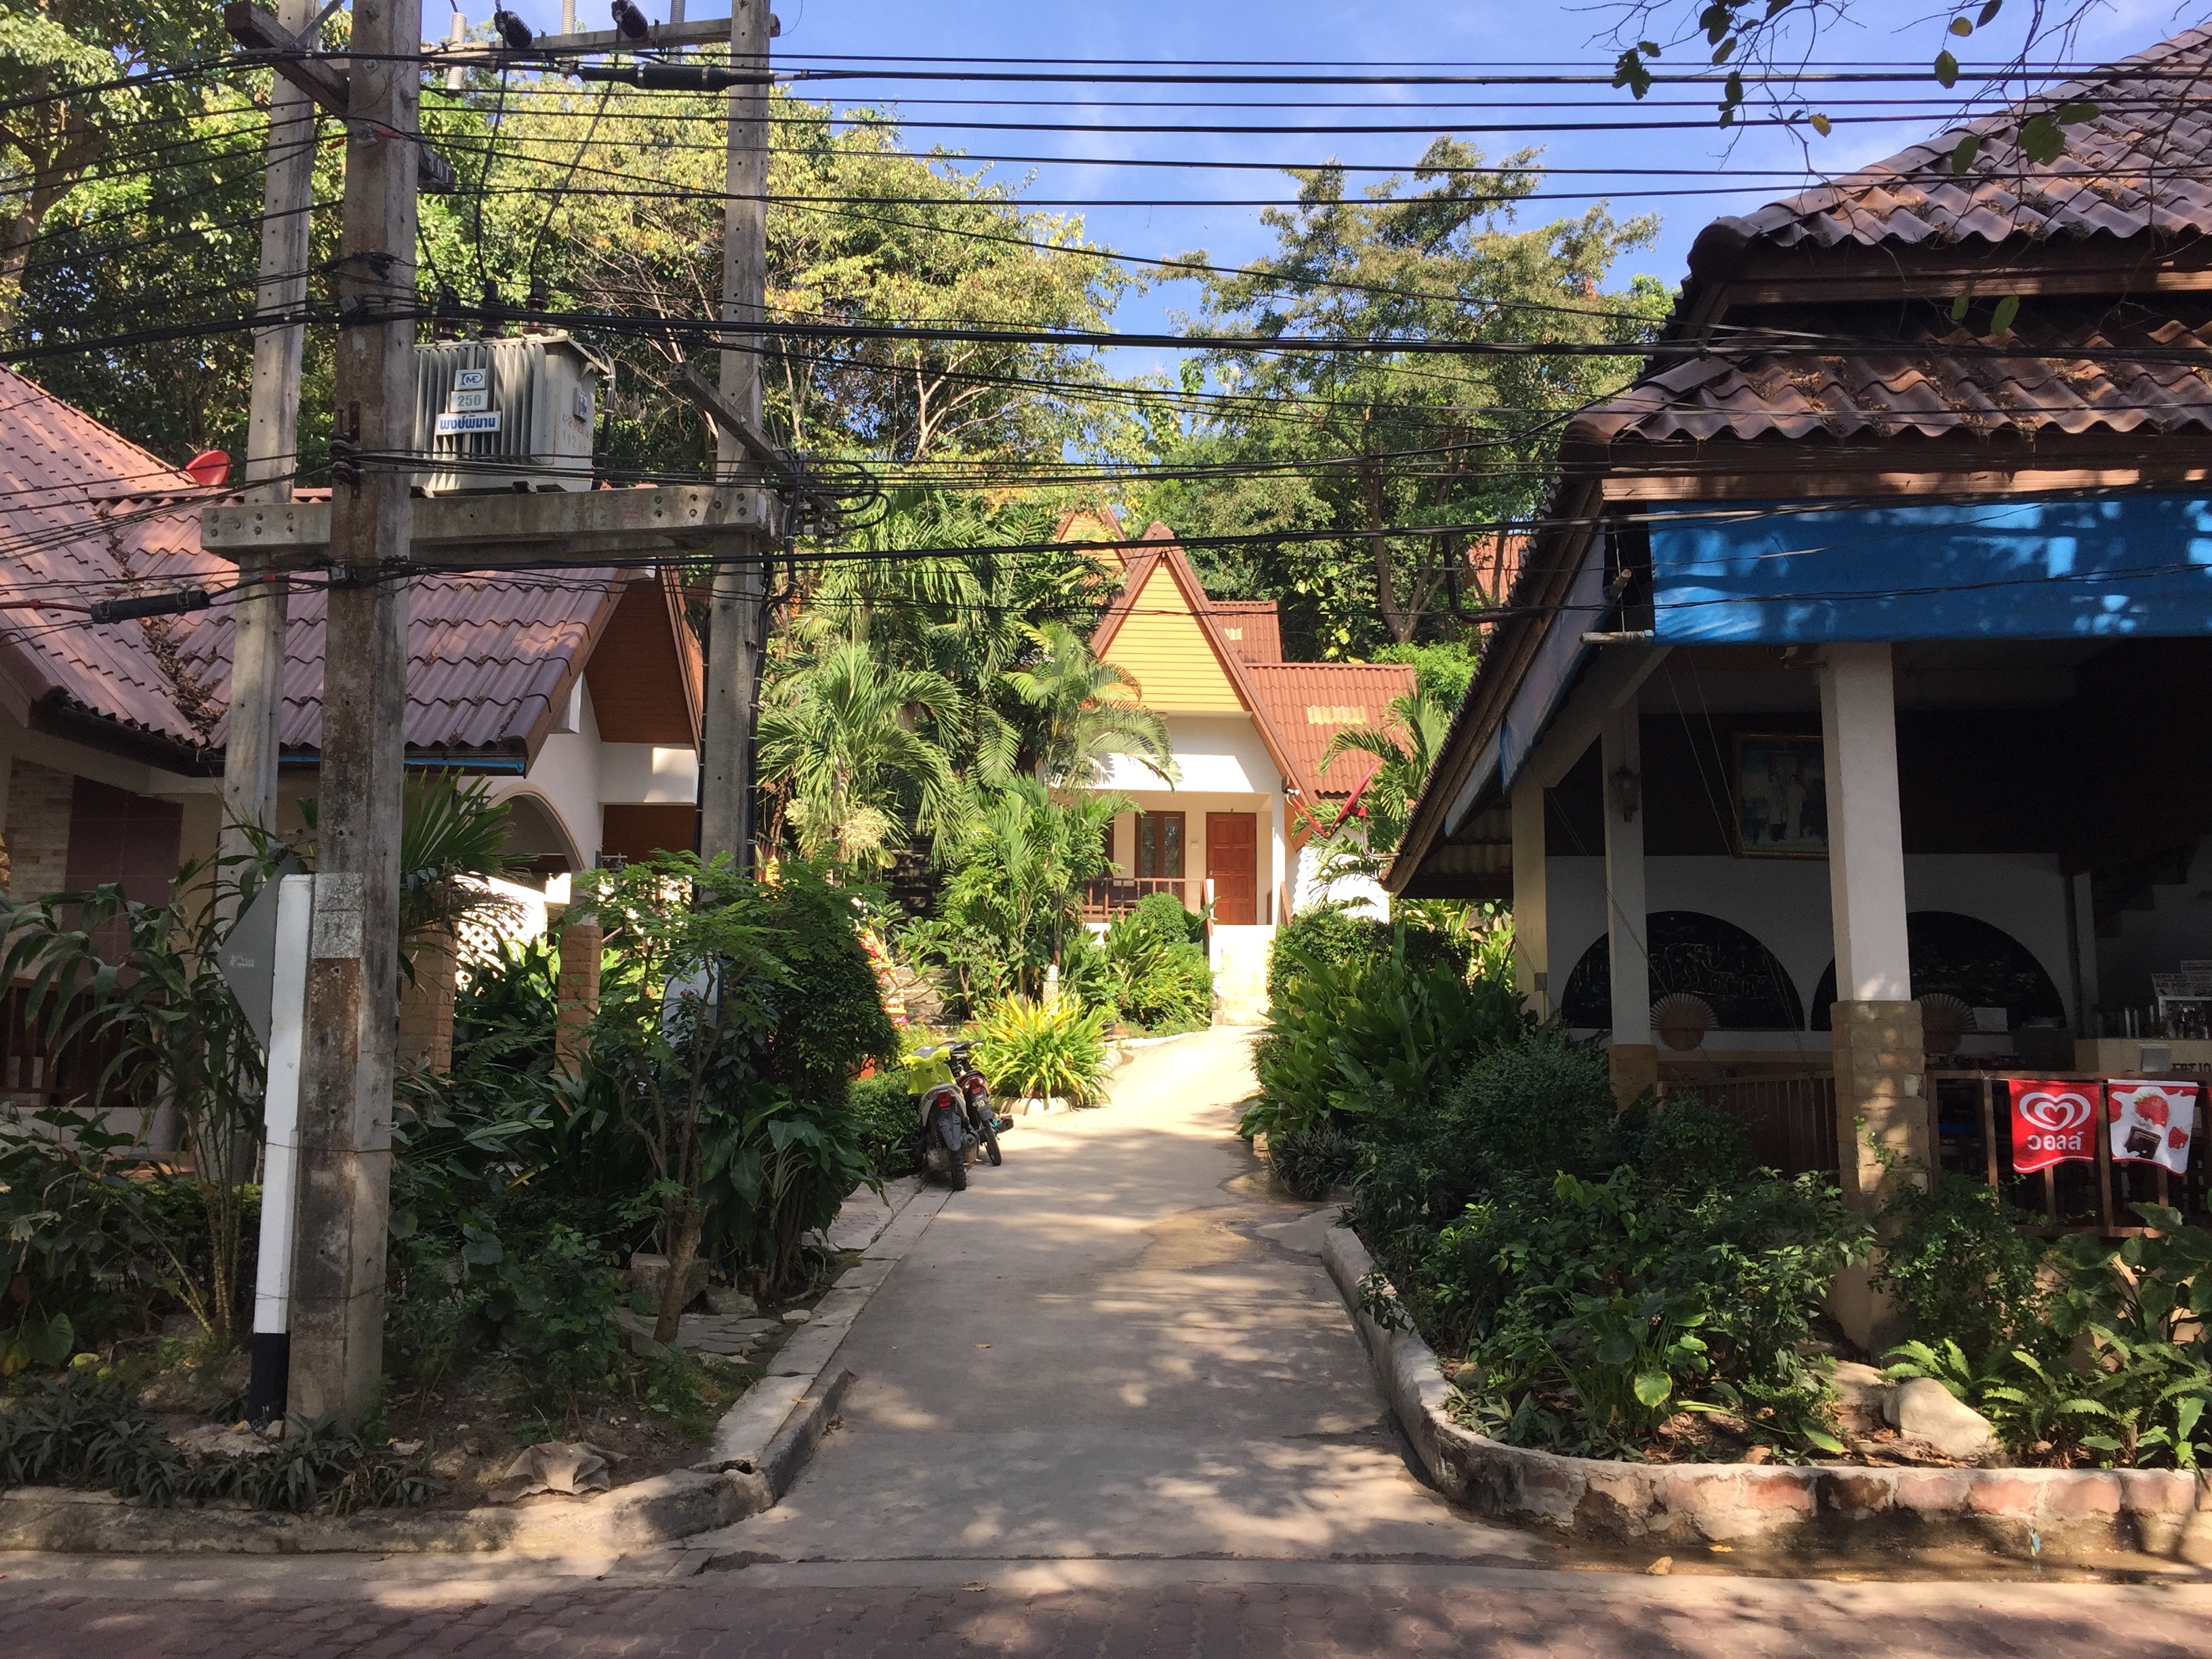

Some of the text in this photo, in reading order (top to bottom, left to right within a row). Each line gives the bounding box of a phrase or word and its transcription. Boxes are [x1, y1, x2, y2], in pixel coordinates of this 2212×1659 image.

[457, 394, 481, 407] 250
[440, 414, 496, 430] พงษ์พิมาน
[977, 1099, 985, 1108] 10
[2027, 1131, 2084, 1151] วอลล์
